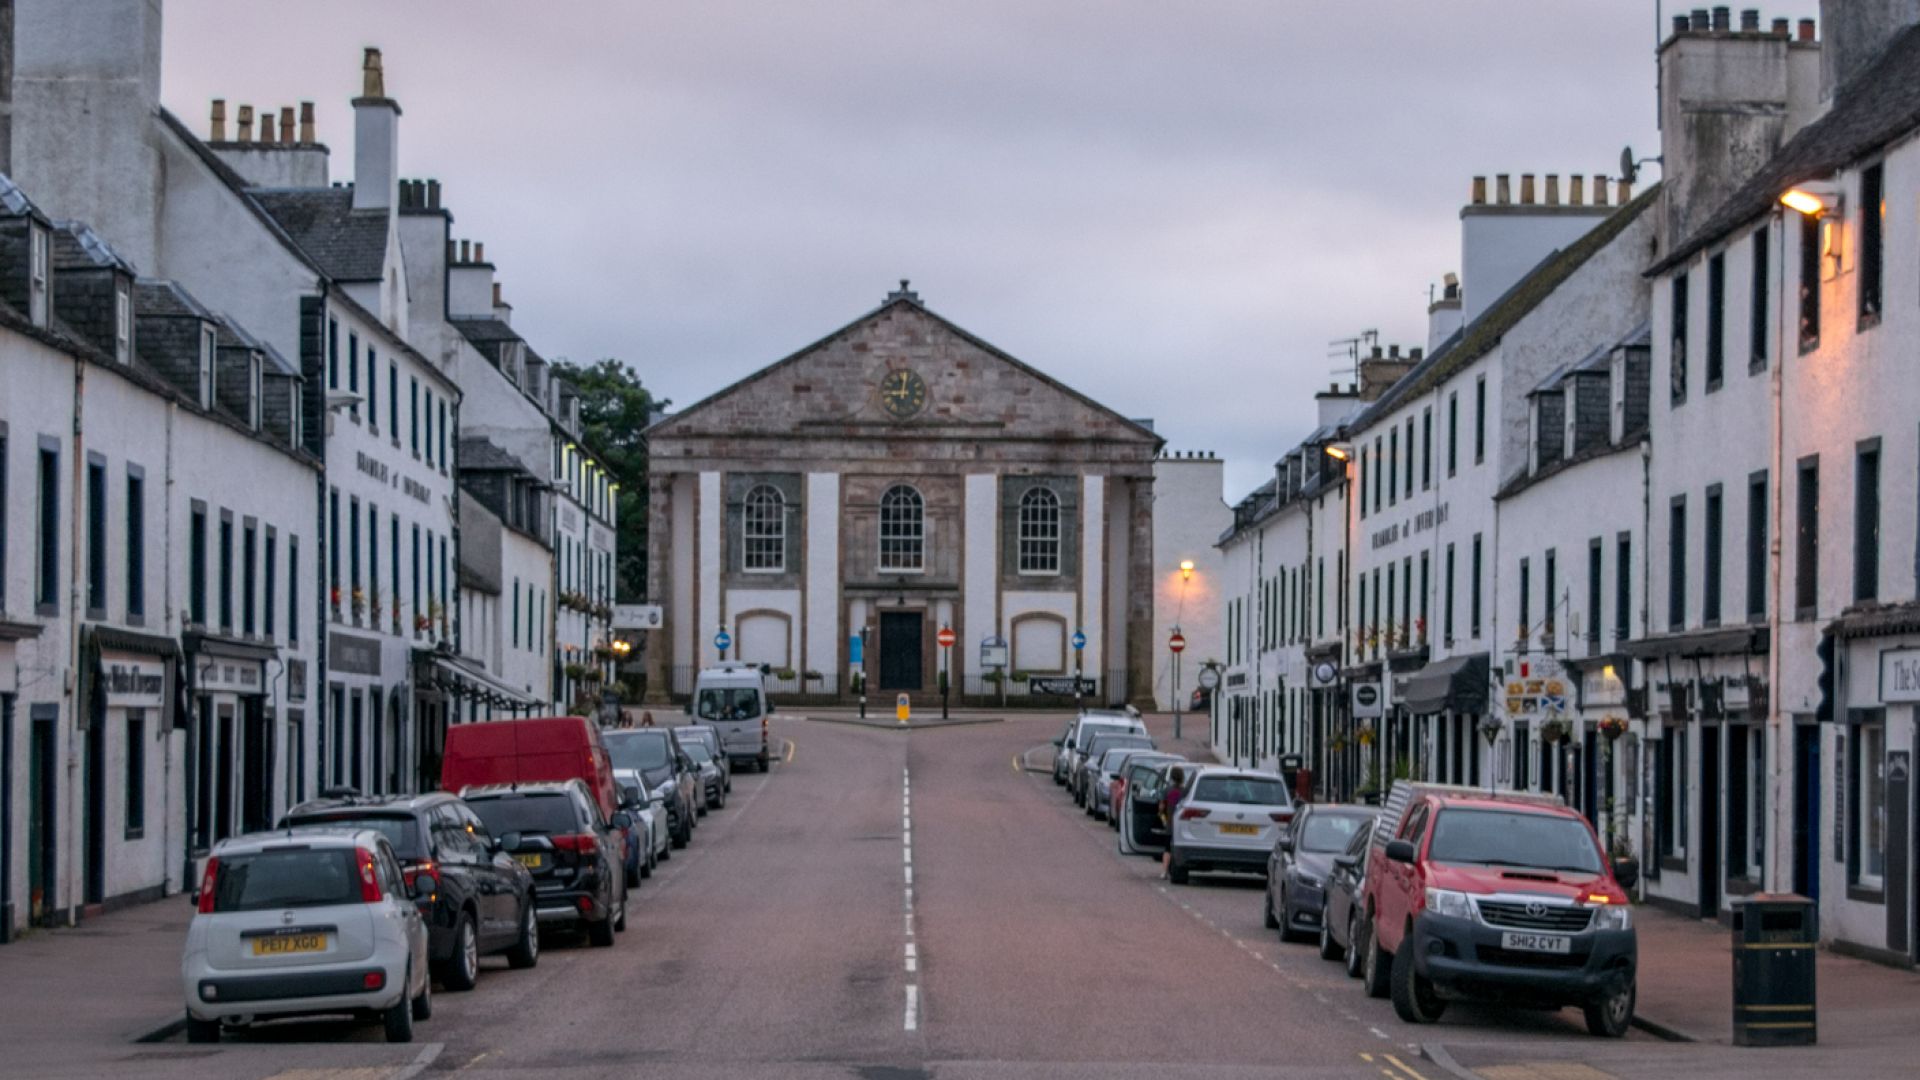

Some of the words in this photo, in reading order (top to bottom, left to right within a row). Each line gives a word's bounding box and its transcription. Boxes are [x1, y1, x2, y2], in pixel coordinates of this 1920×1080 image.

[1894, 659, 1910, 691] The
[261, 937, 289, 952] PE17
[1509, 934, 1536, 949] SH12
[1538, 937, 1562, 950] CVT
